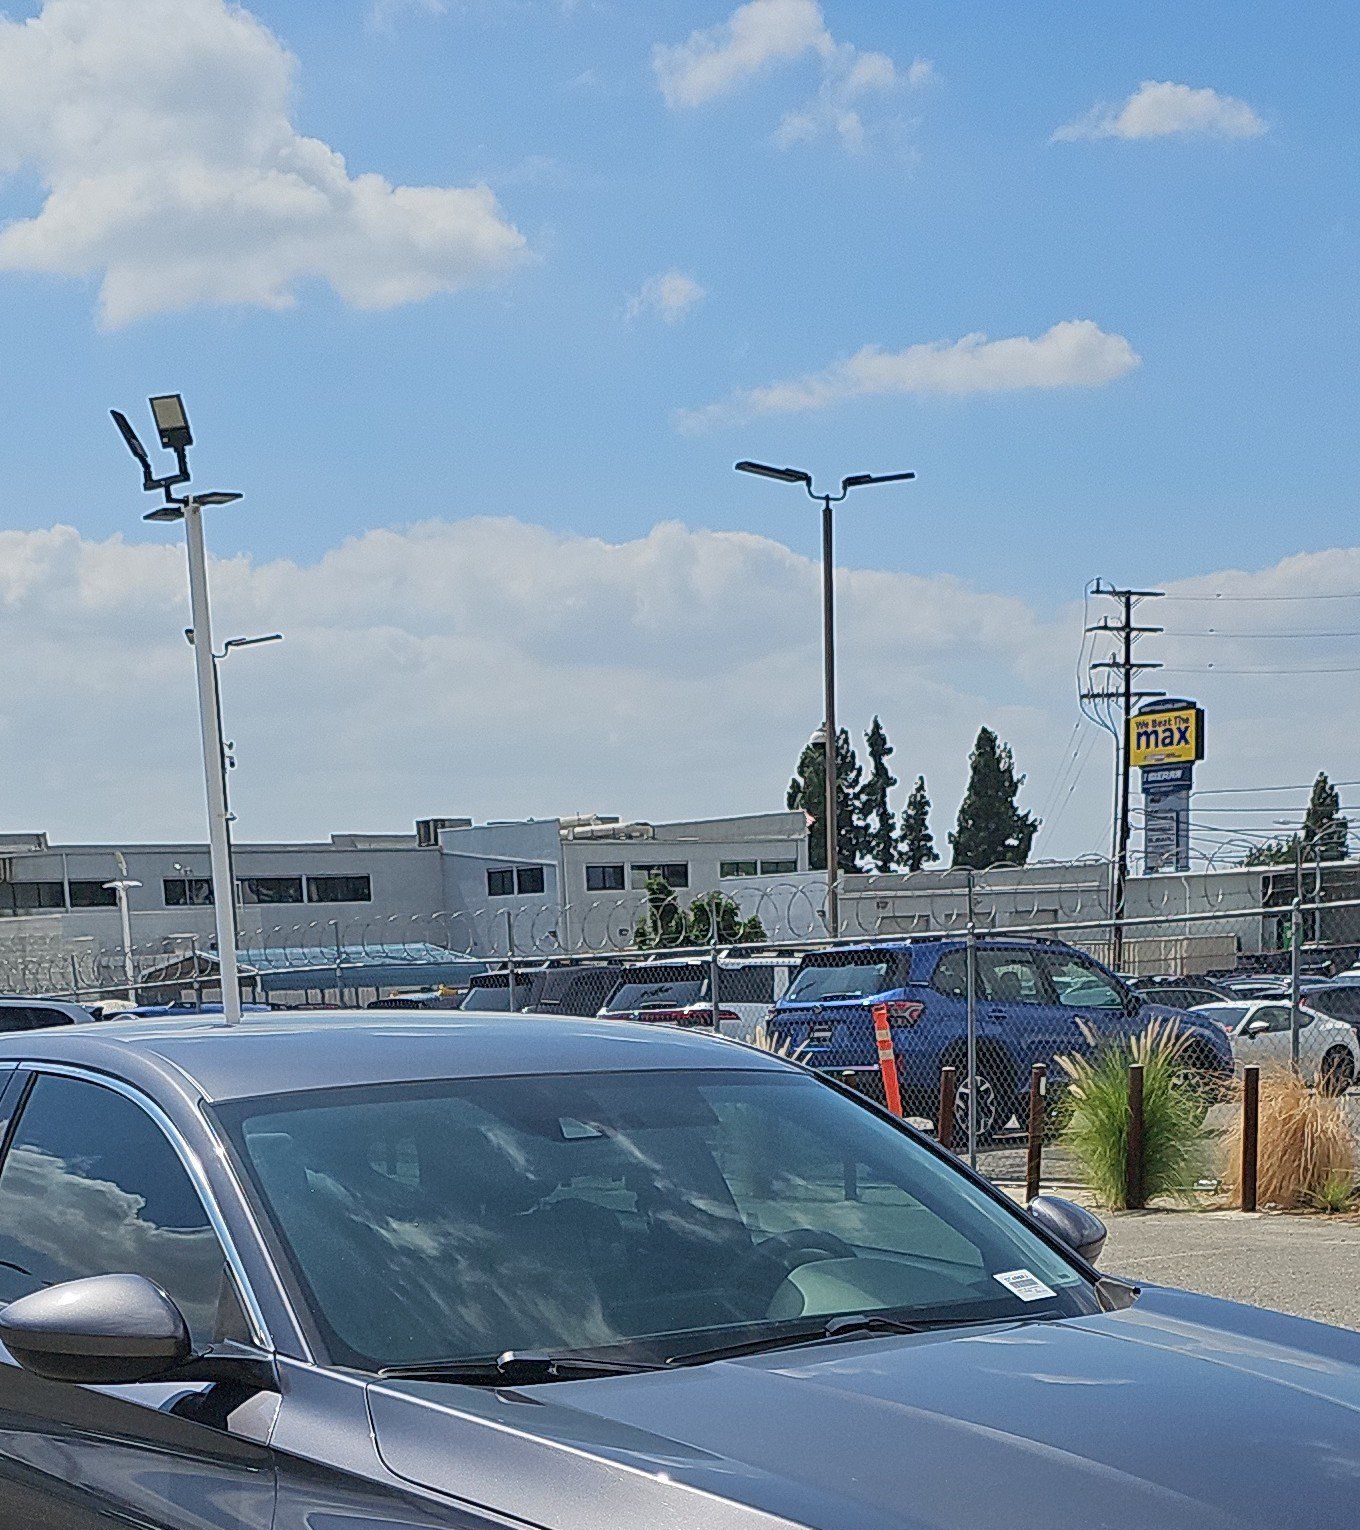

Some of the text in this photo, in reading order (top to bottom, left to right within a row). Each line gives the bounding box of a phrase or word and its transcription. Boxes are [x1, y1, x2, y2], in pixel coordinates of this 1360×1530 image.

[1151, 718, 1172, 729] Beat
[1174, 715, 1190, 726] The
[1135, 725, 1191, 750] max
